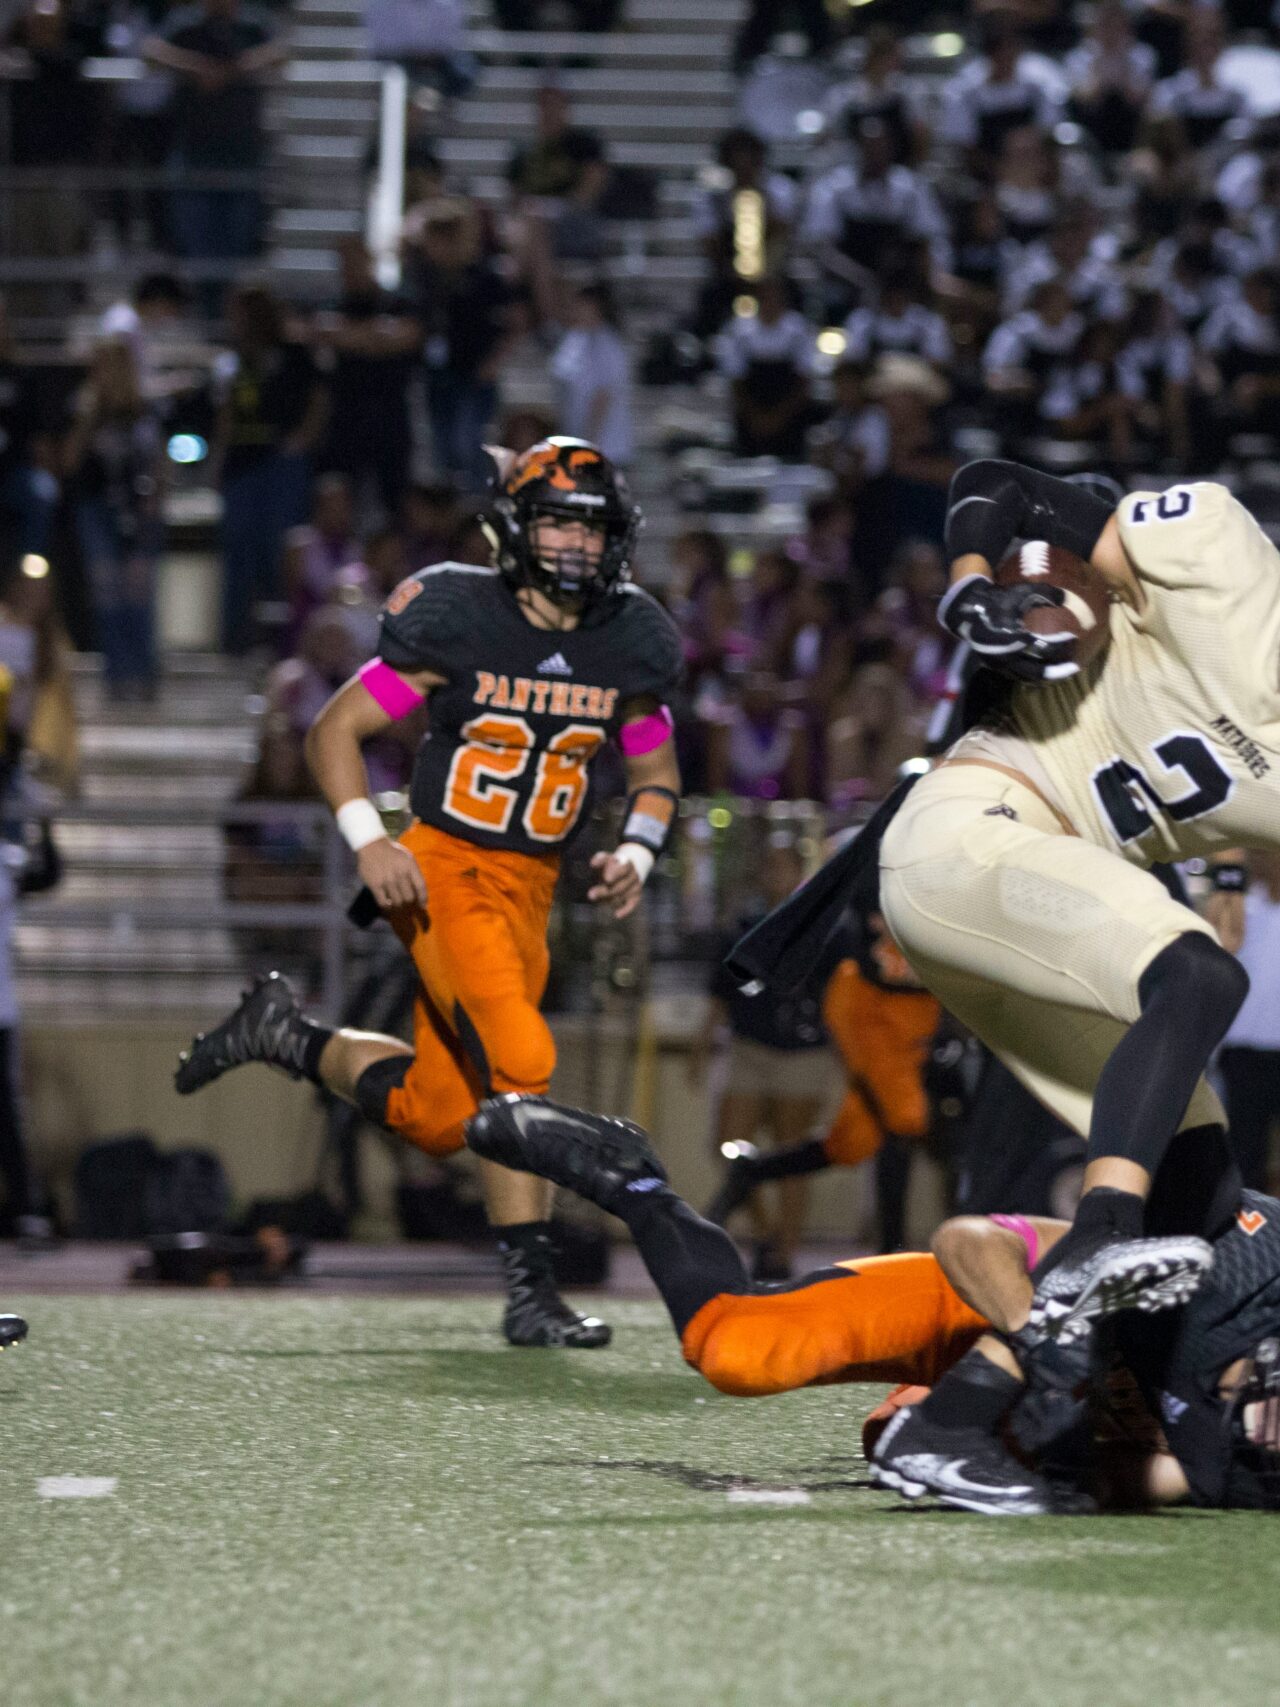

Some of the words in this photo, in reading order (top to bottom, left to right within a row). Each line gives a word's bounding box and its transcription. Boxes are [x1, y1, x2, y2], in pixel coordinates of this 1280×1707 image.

[1130, 489, 1194, 526] 2
[473, 671, 619, 720] PANTHERS
[442, 711, 607, 843] 28
[1089, 730, 1237, 845] 2
